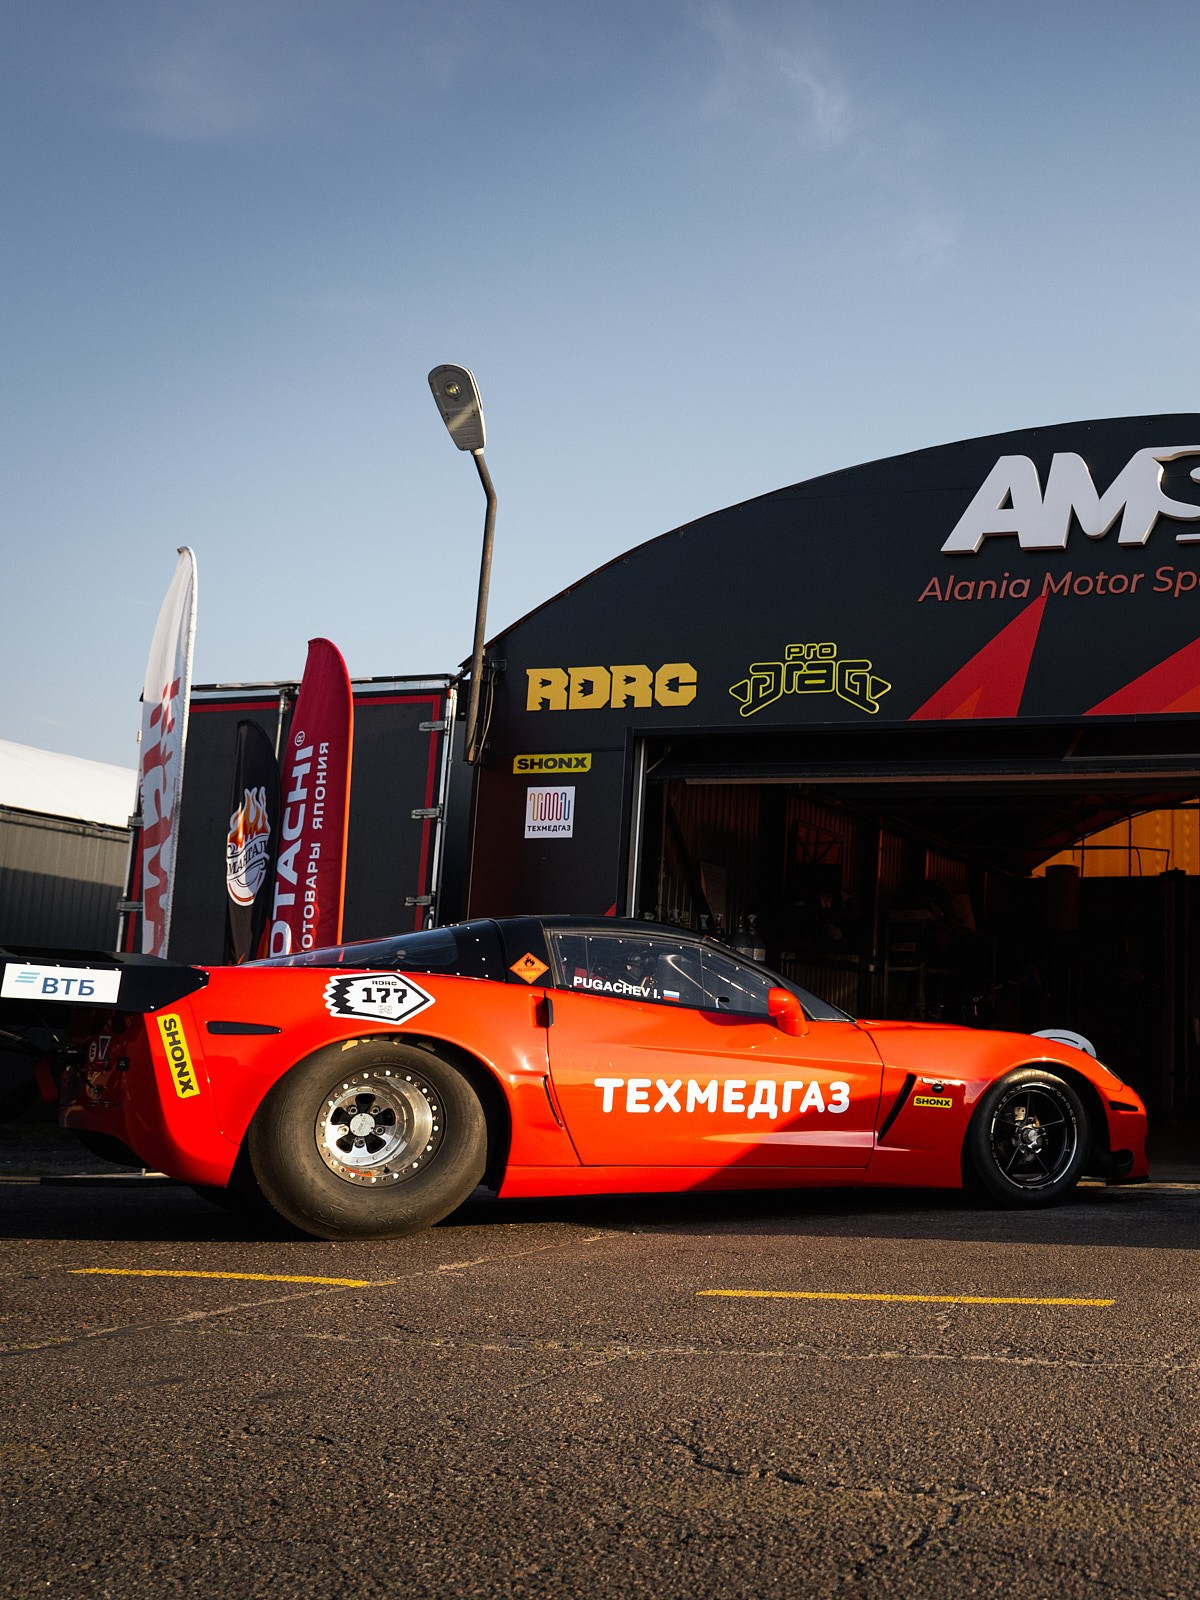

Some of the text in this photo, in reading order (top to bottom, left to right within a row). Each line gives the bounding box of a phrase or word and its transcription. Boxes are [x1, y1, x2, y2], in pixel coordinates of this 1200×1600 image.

[918, 572, 1031, 602] Alania
[1041, 570, 1145, 597] Motor
[526, 662, 698, 711] RDRC
[517, 757, 587, 770] SHONX
[312, 742, 329, 829] ЯПОНИЯ
[42, 977, 95, 996] ВТБ
[362, 987, 408, 1004] 177
[573, 976, 650, 998] PUGACHEV
[163, 1017, 194, 1094] SHONX
[593, 1078, 850, 1120] ТЕХМЕДГАЗ
[916, 1098, 950, 1106] SHONX
